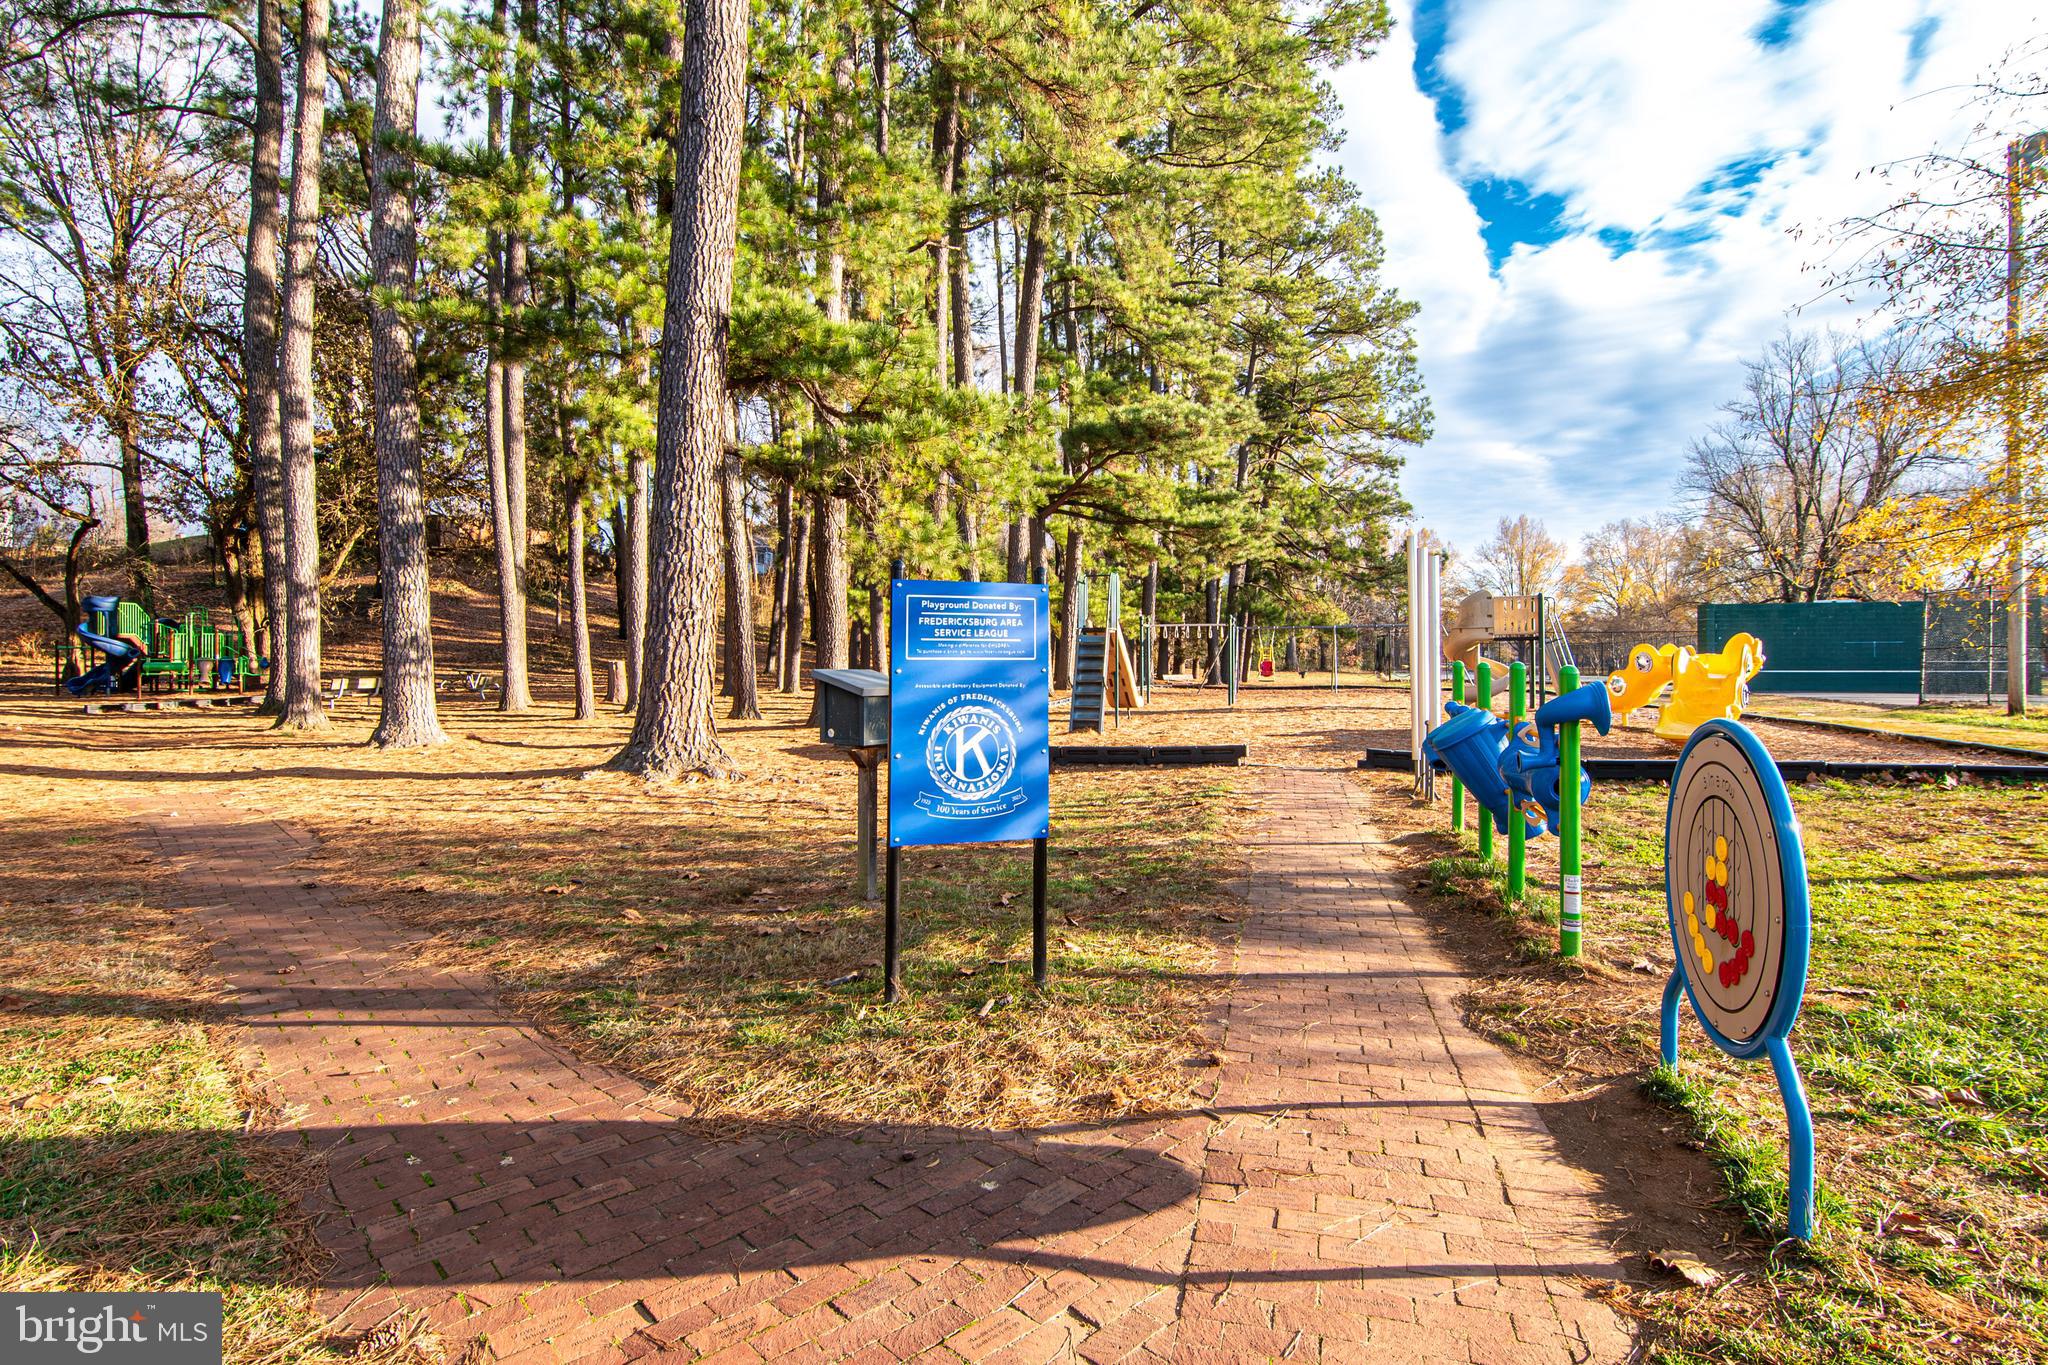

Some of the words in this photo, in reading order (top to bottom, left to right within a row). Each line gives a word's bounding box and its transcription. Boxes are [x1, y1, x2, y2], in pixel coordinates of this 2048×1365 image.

[921, 600, 970, 610] Playground
[972, 601, 1006, 610] Donated
[1009, 602, 1022, 612] By:
[918, 617, 998, 626] FREDERICKSBURG
[1000, 618, 1024, 627] AREA
[934, 628, 972, 637] SERVICE
[974, 629, 1009, 638] LEAGUE
[918, 702, 946, 736] KIWANIS
[947, 695, 959, 705] OF
[960, 693, 1025, 734] FREDERICKSBURG
[943, 713, 1002, 736] KIWANIS
[954, 724, 993, 780] K
[933, 743, 1010, 793] INTERNATIONAL
[936, 804, 950, 813] 100
[951, 806, 970, 815] Years
[971, 806, 981, 815] of
[982, 803, 1007, 814] Service
